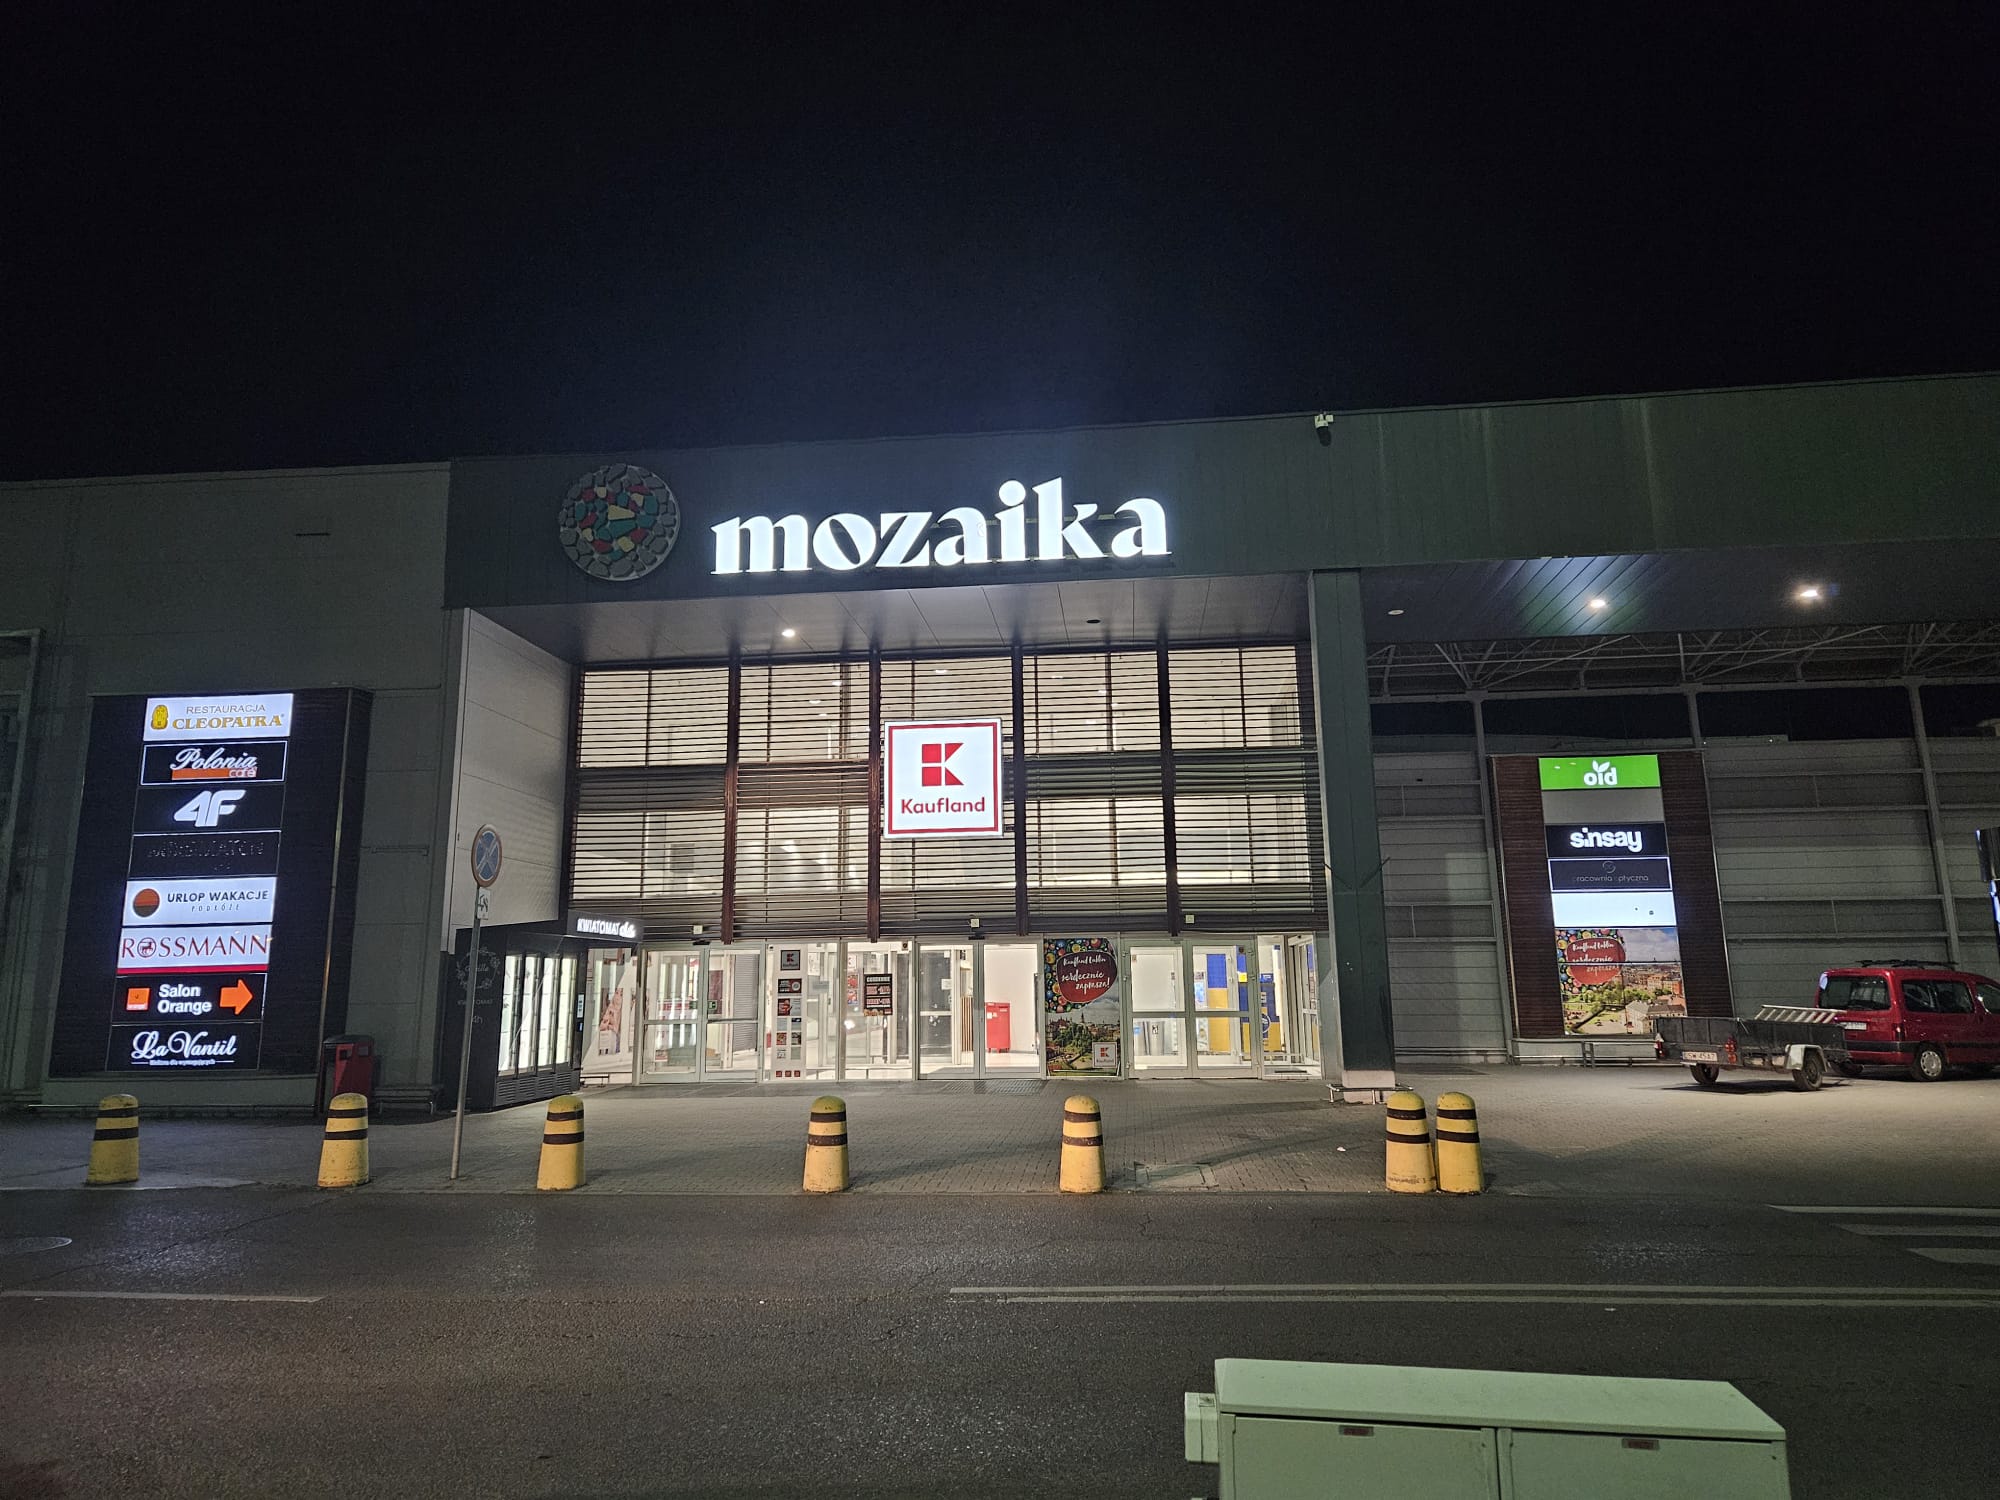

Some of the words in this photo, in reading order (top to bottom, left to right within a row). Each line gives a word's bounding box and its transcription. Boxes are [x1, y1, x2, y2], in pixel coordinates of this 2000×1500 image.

[710, 477, 1173, 575] mozaika
[186, 704, 266, 715] RESTAURACJA
[172, 715, 282, 730] CLEOPATRA
[170, 747, 258, 770] Polonia
[174, 790, 247, 827] 4F
[901, 797, 985, 814] Kaufland
[1570, 827, 1643, 853] sinsay
[1574, 875, 1613, 883] racownia
[1616, 874, 1649, 883] ptyczna
[167, 893, 206, 903] URLOP
[209, 891, 269, 902] WAKACJE
[577, 918, 620, 936] KWIATOMAT
[122, 935, 269, 959] ROSSMANN
[159, 984, 201, 998] Salon
[157, 1000, 213, 1016] Orange
[131, 1031, 169, 1059] La
[167, 1031, 237, 1058] Vantil
